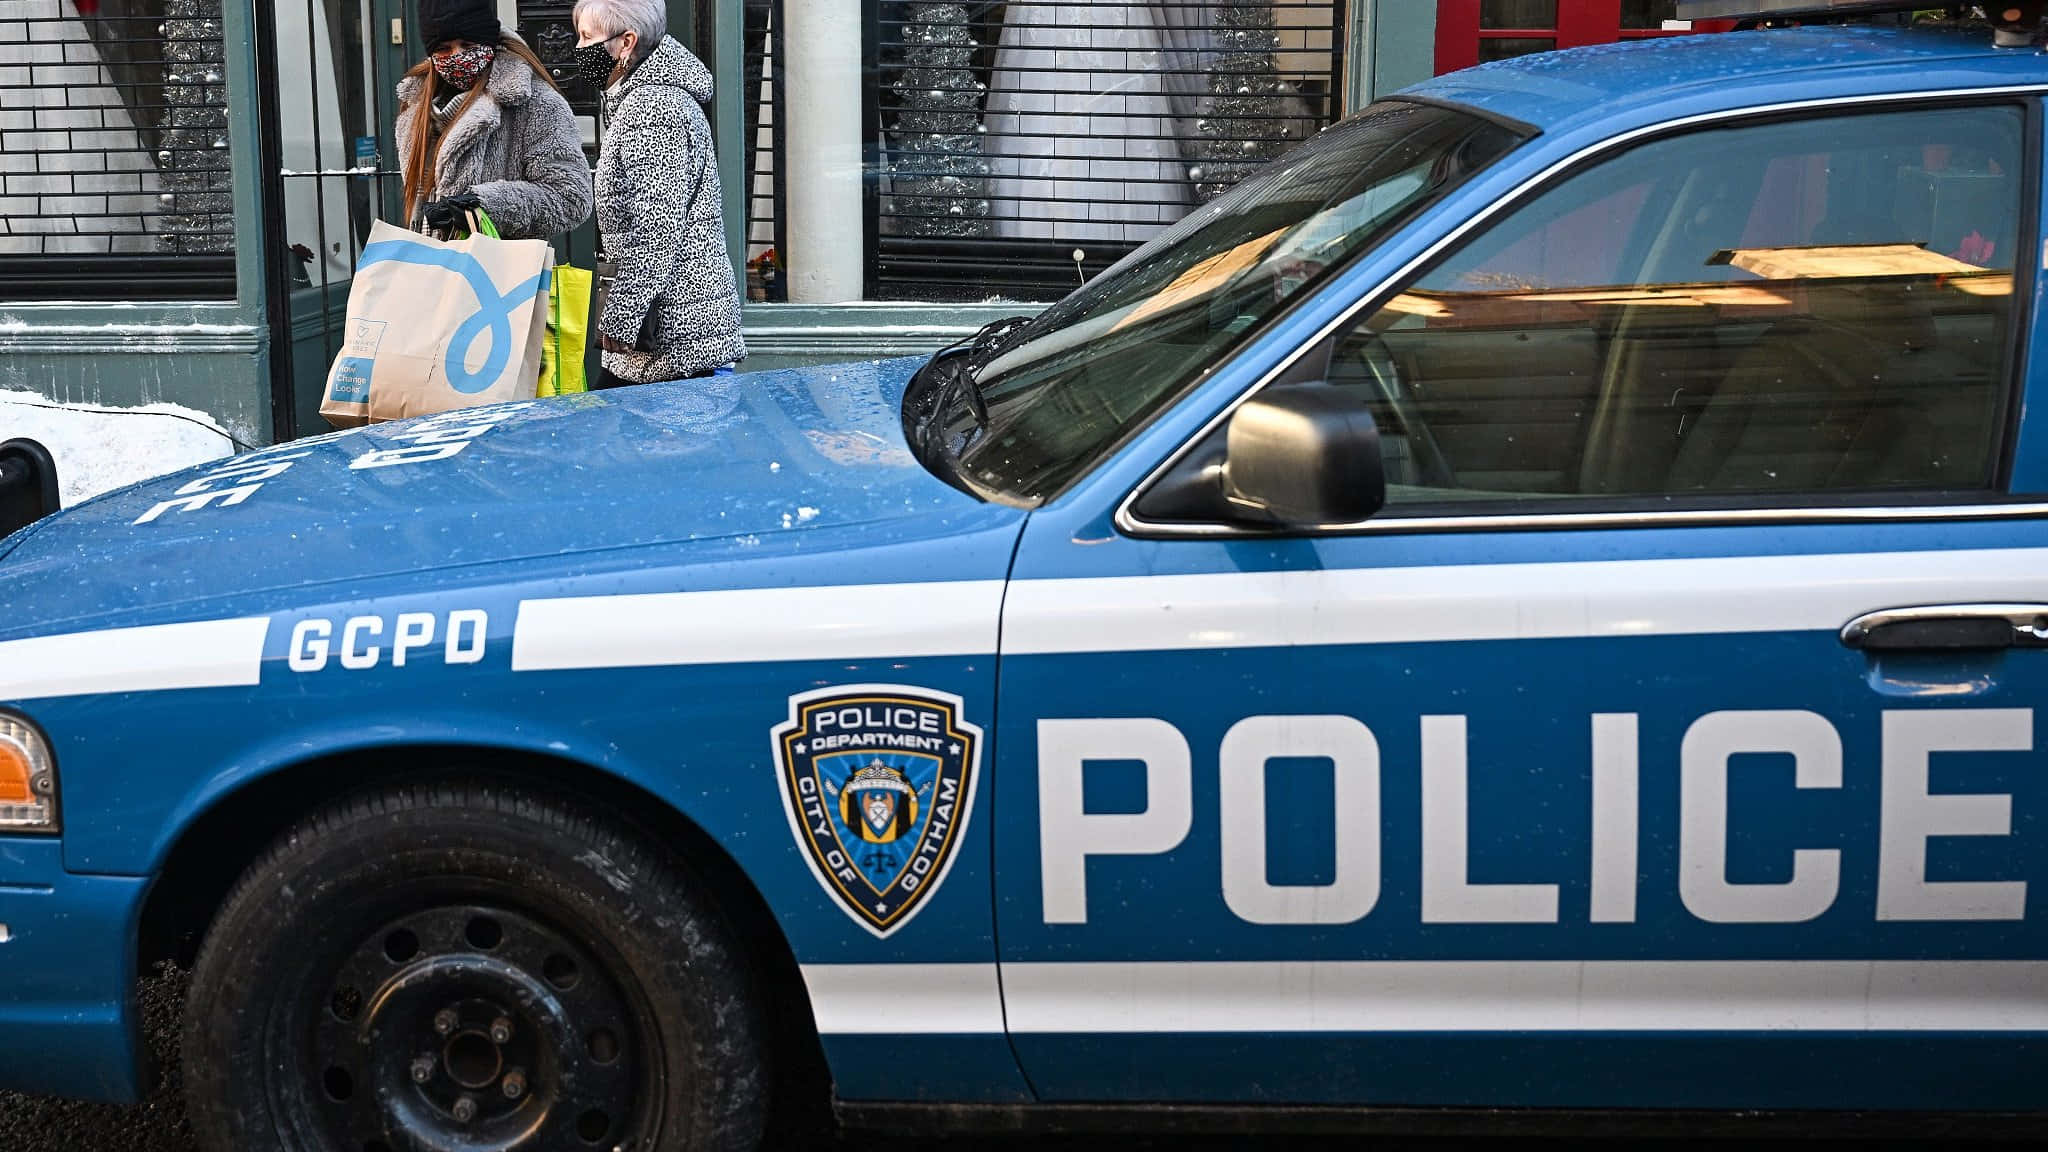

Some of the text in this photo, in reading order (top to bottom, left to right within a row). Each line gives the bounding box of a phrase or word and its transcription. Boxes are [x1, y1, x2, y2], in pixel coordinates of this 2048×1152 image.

[336, 374, 366, 384] Change
[288, 608, 488, 672] GCPD
[812, 733, 944, 750] DEPARTMENT
[815, 707, 940, 733] POLICE
[799, 776, 958, 892] CITY OF GOTHAM
[1037, 707, 2034, 925] POLICE
